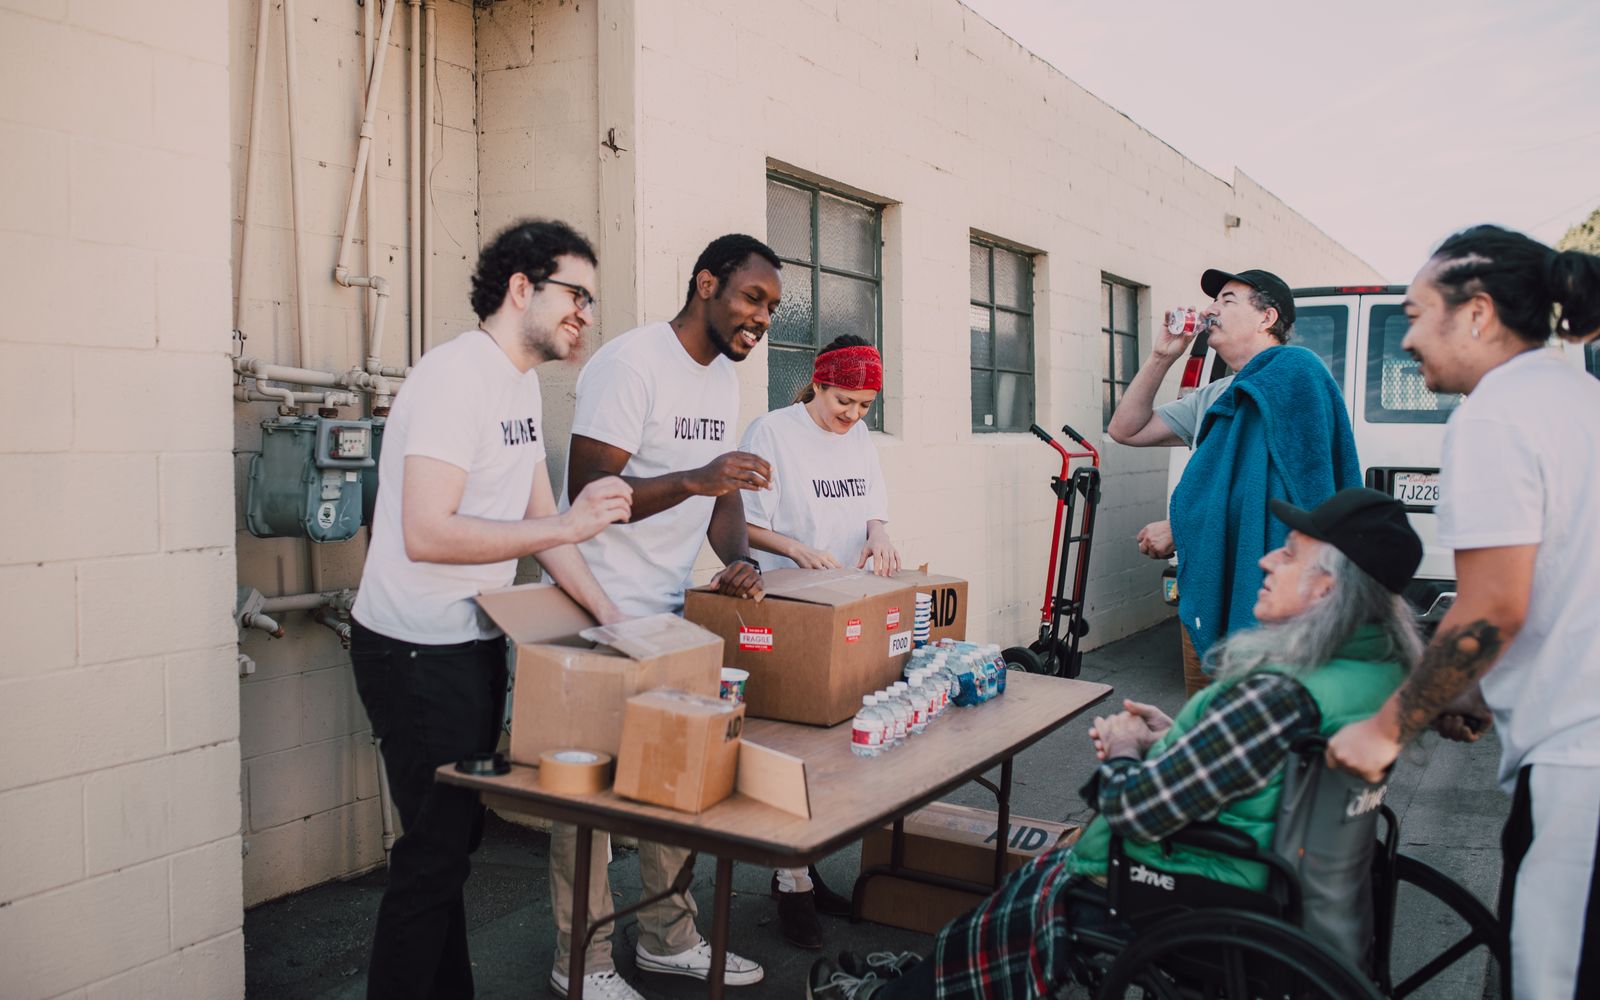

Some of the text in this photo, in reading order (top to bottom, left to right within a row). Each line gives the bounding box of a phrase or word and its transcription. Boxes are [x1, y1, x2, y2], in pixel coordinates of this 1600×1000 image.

[929, 588, 958, 627] AID
[742, 635, 770, 644] FRAGILE
[892, 636, 909, 652] FOOD
